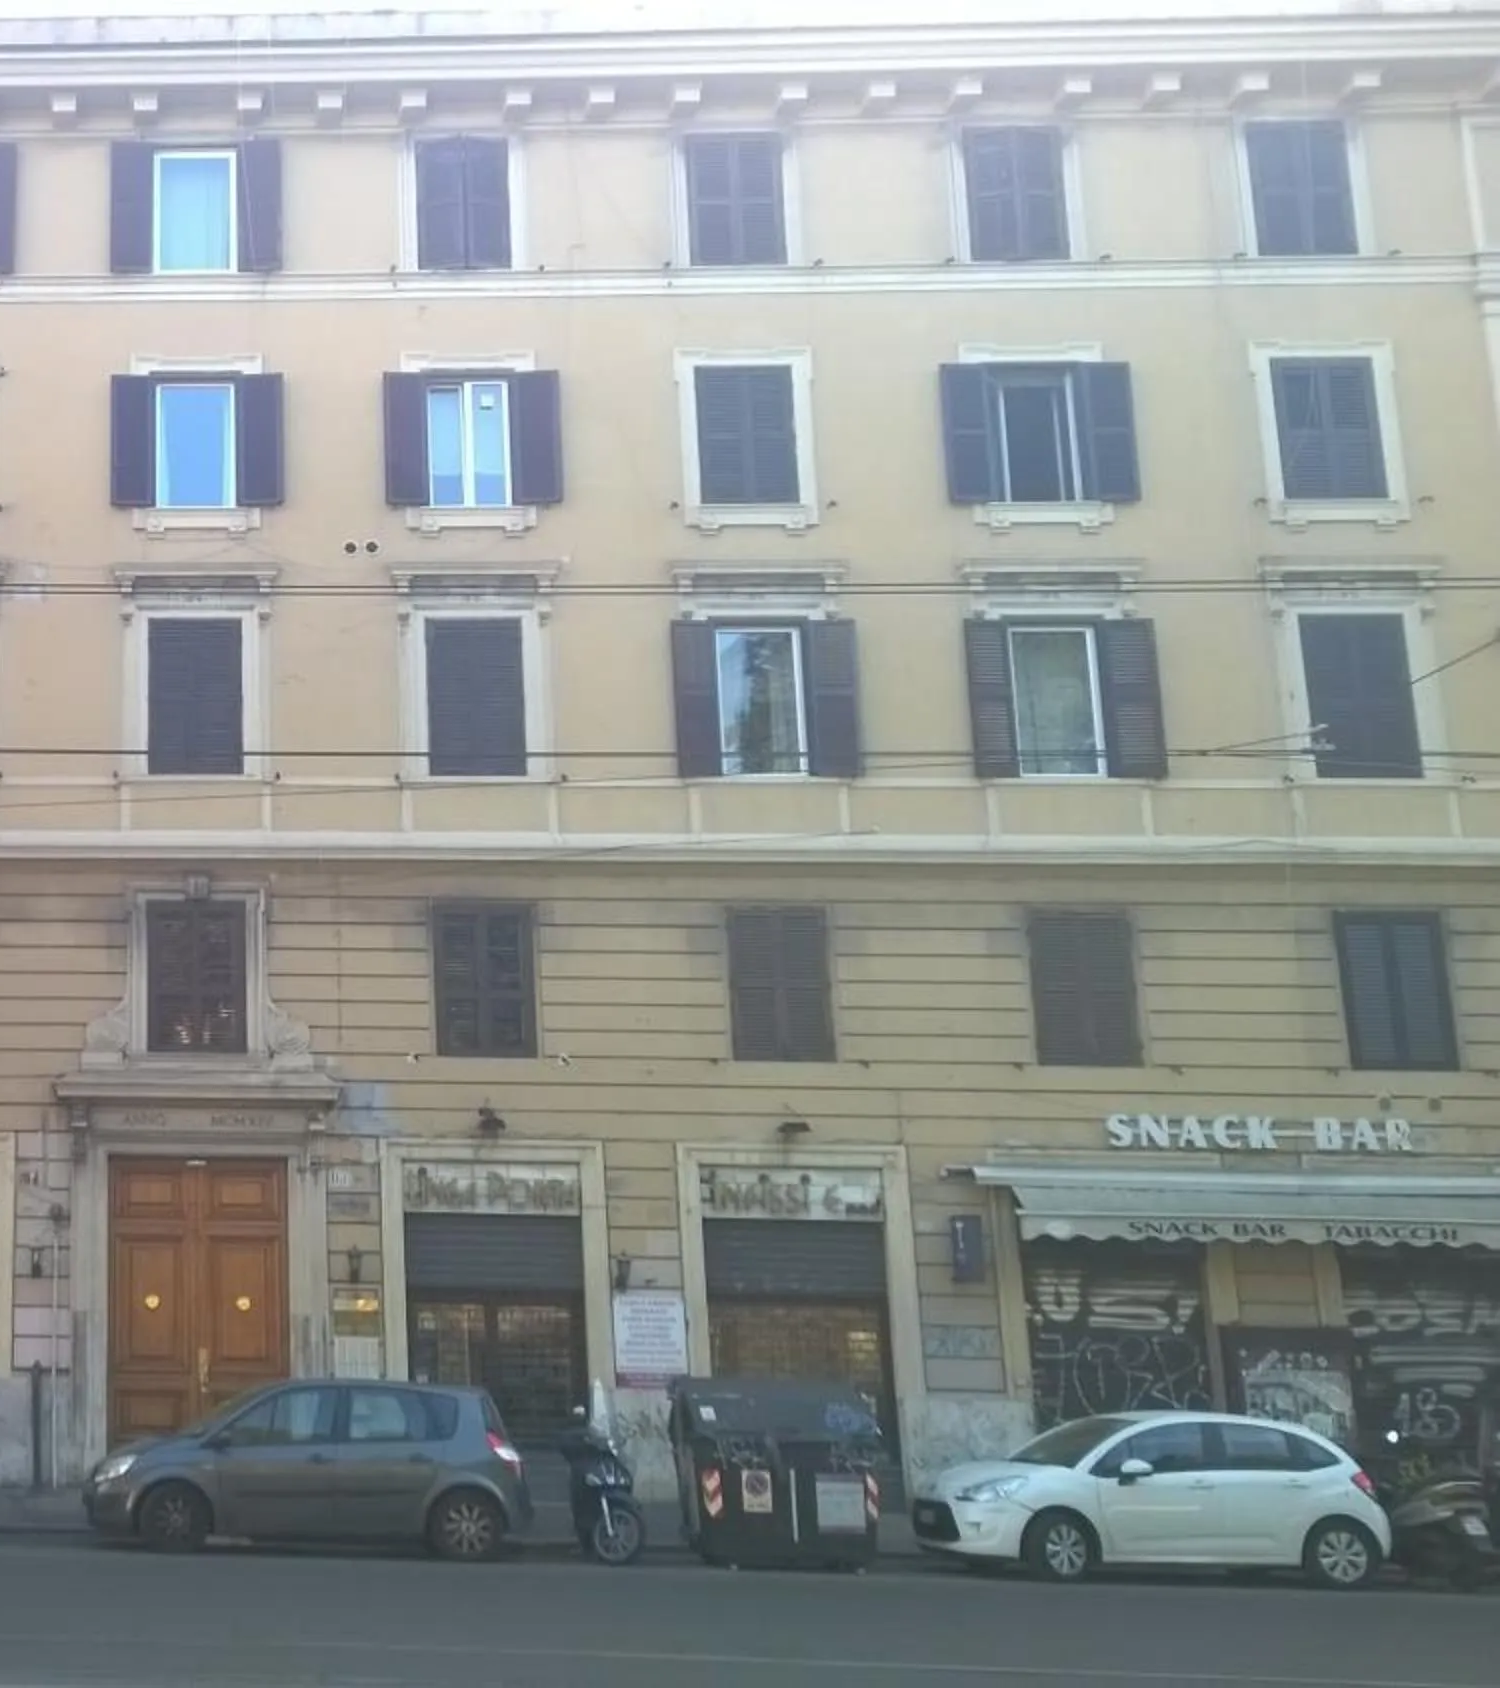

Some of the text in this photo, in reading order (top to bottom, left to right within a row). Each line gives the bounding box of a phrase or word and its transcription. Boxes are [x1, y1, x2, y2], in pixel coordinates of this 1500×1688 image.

[122, 1113, 167, 1128] ANNO
[1104, 1113, 1414, 1151] SNACK BAR
[1127, 1220, 1460, 1241] SNACK BAR TABACCHI
